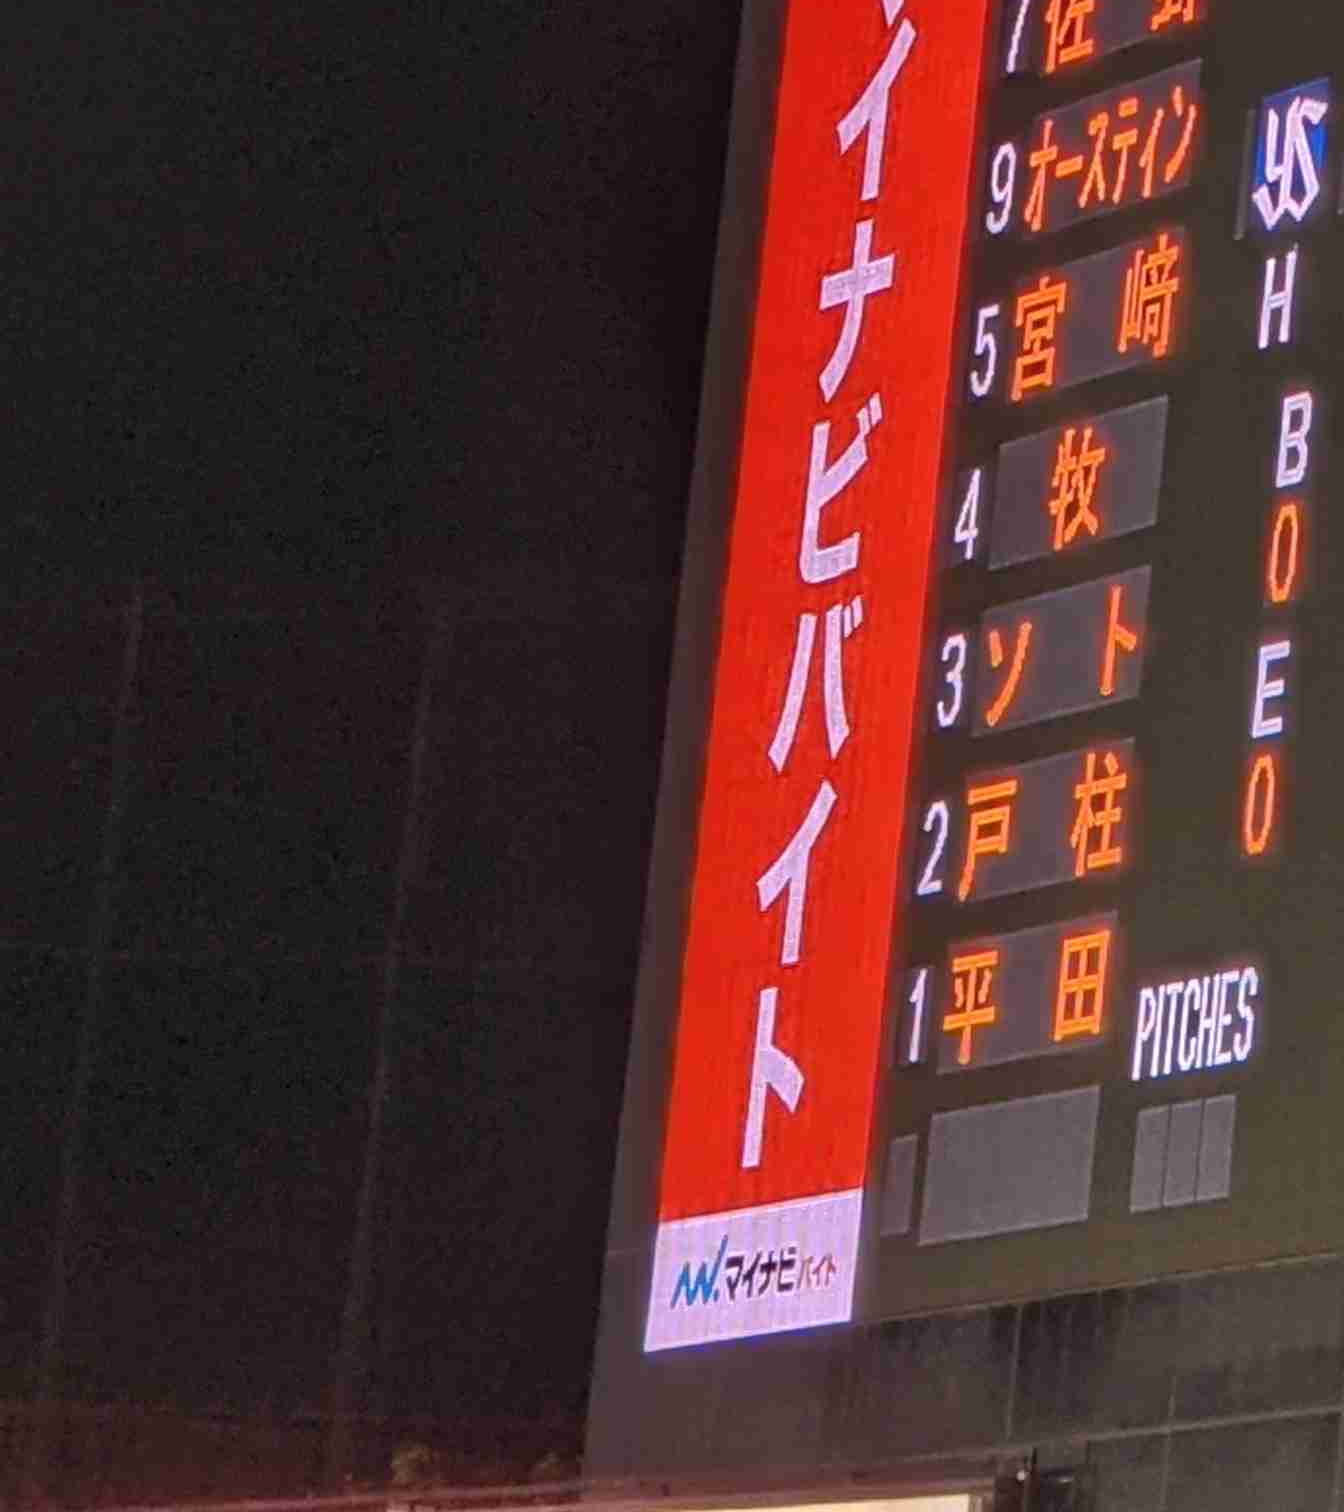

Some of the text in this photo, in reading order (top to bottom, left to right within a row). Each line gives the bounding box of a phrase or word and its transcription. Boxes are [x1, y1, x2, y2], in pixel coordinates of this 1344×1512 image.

[985, 142, 1017, 235] 9
[1257, 242, 1299, 350] H
[969, 304, 1000, 398] 5
[1275, 389, 1313, 489] B
[953, 425, 1107, 560] 4 牧
[1268, 502, 1300, 604] 0
[936, 633, 968, 728] 3
[1251, 639, 1291, 740] E
[916, 799, 949, 896] 2
[1243, 754, 1276, 856] 0
[908, 967, 929, 1063] 1
[1131, 966, 1259, 1082] PITCHES
